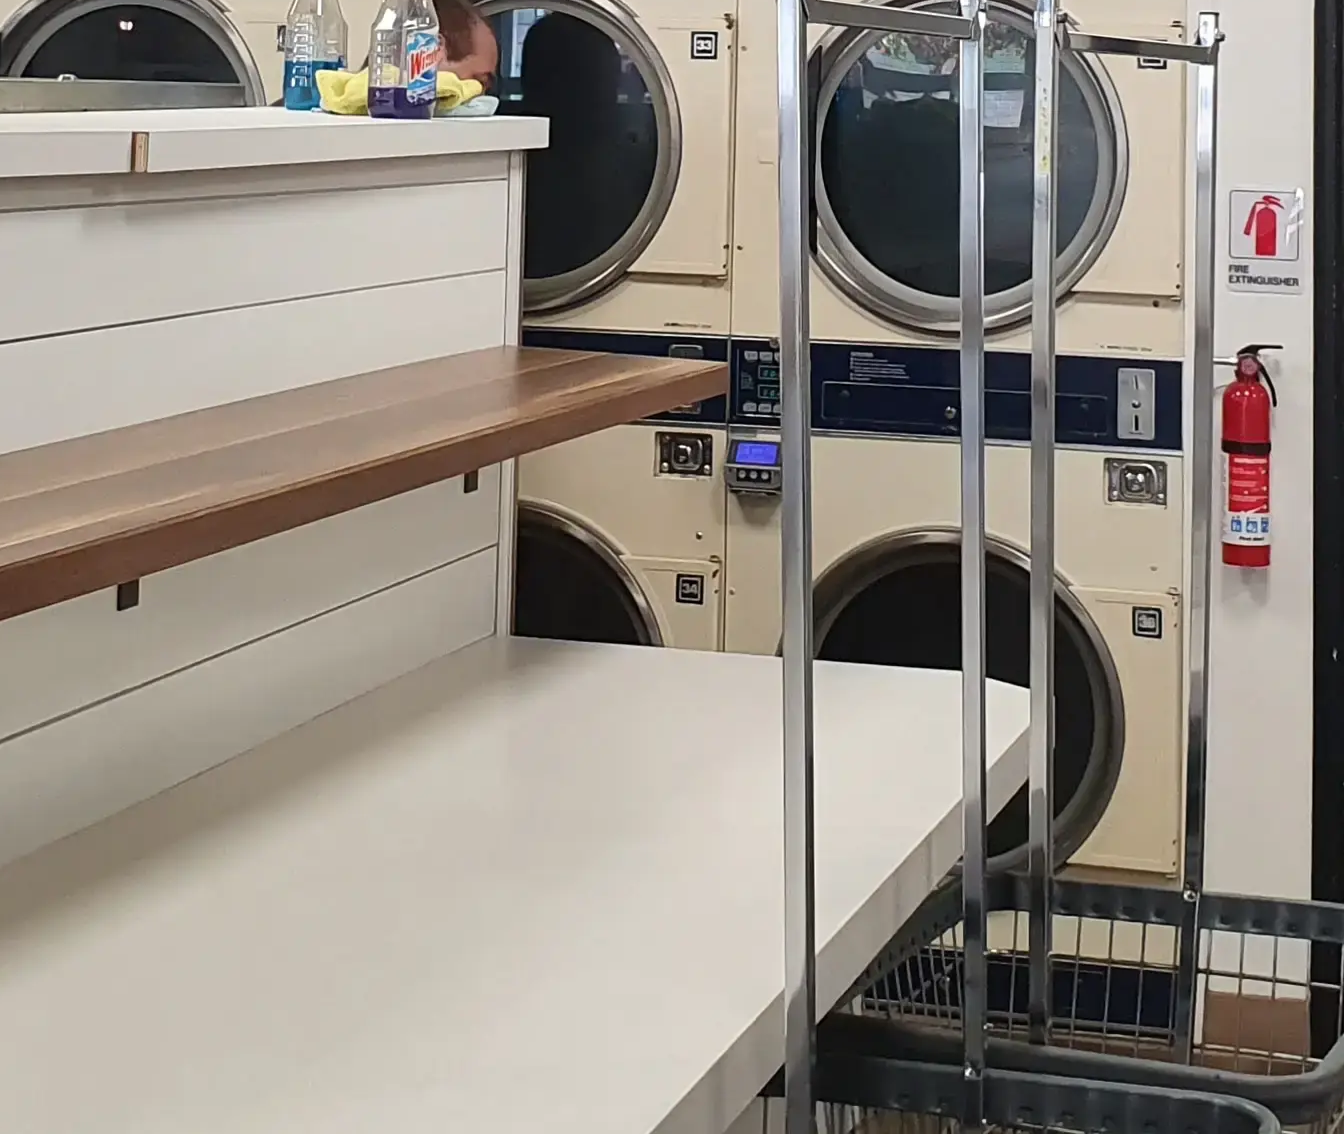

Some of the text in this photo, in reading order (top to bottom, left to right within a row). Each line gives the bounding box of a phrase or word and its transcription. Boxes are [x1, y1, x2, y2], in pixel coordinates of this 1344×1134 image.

[696, 39, 712, 50] 33
[1228, 264, 1249, 274] FIRE
[1228, 275, 1300, 287] EXTINGUISHER
[682, 583, 698, 594] 34
